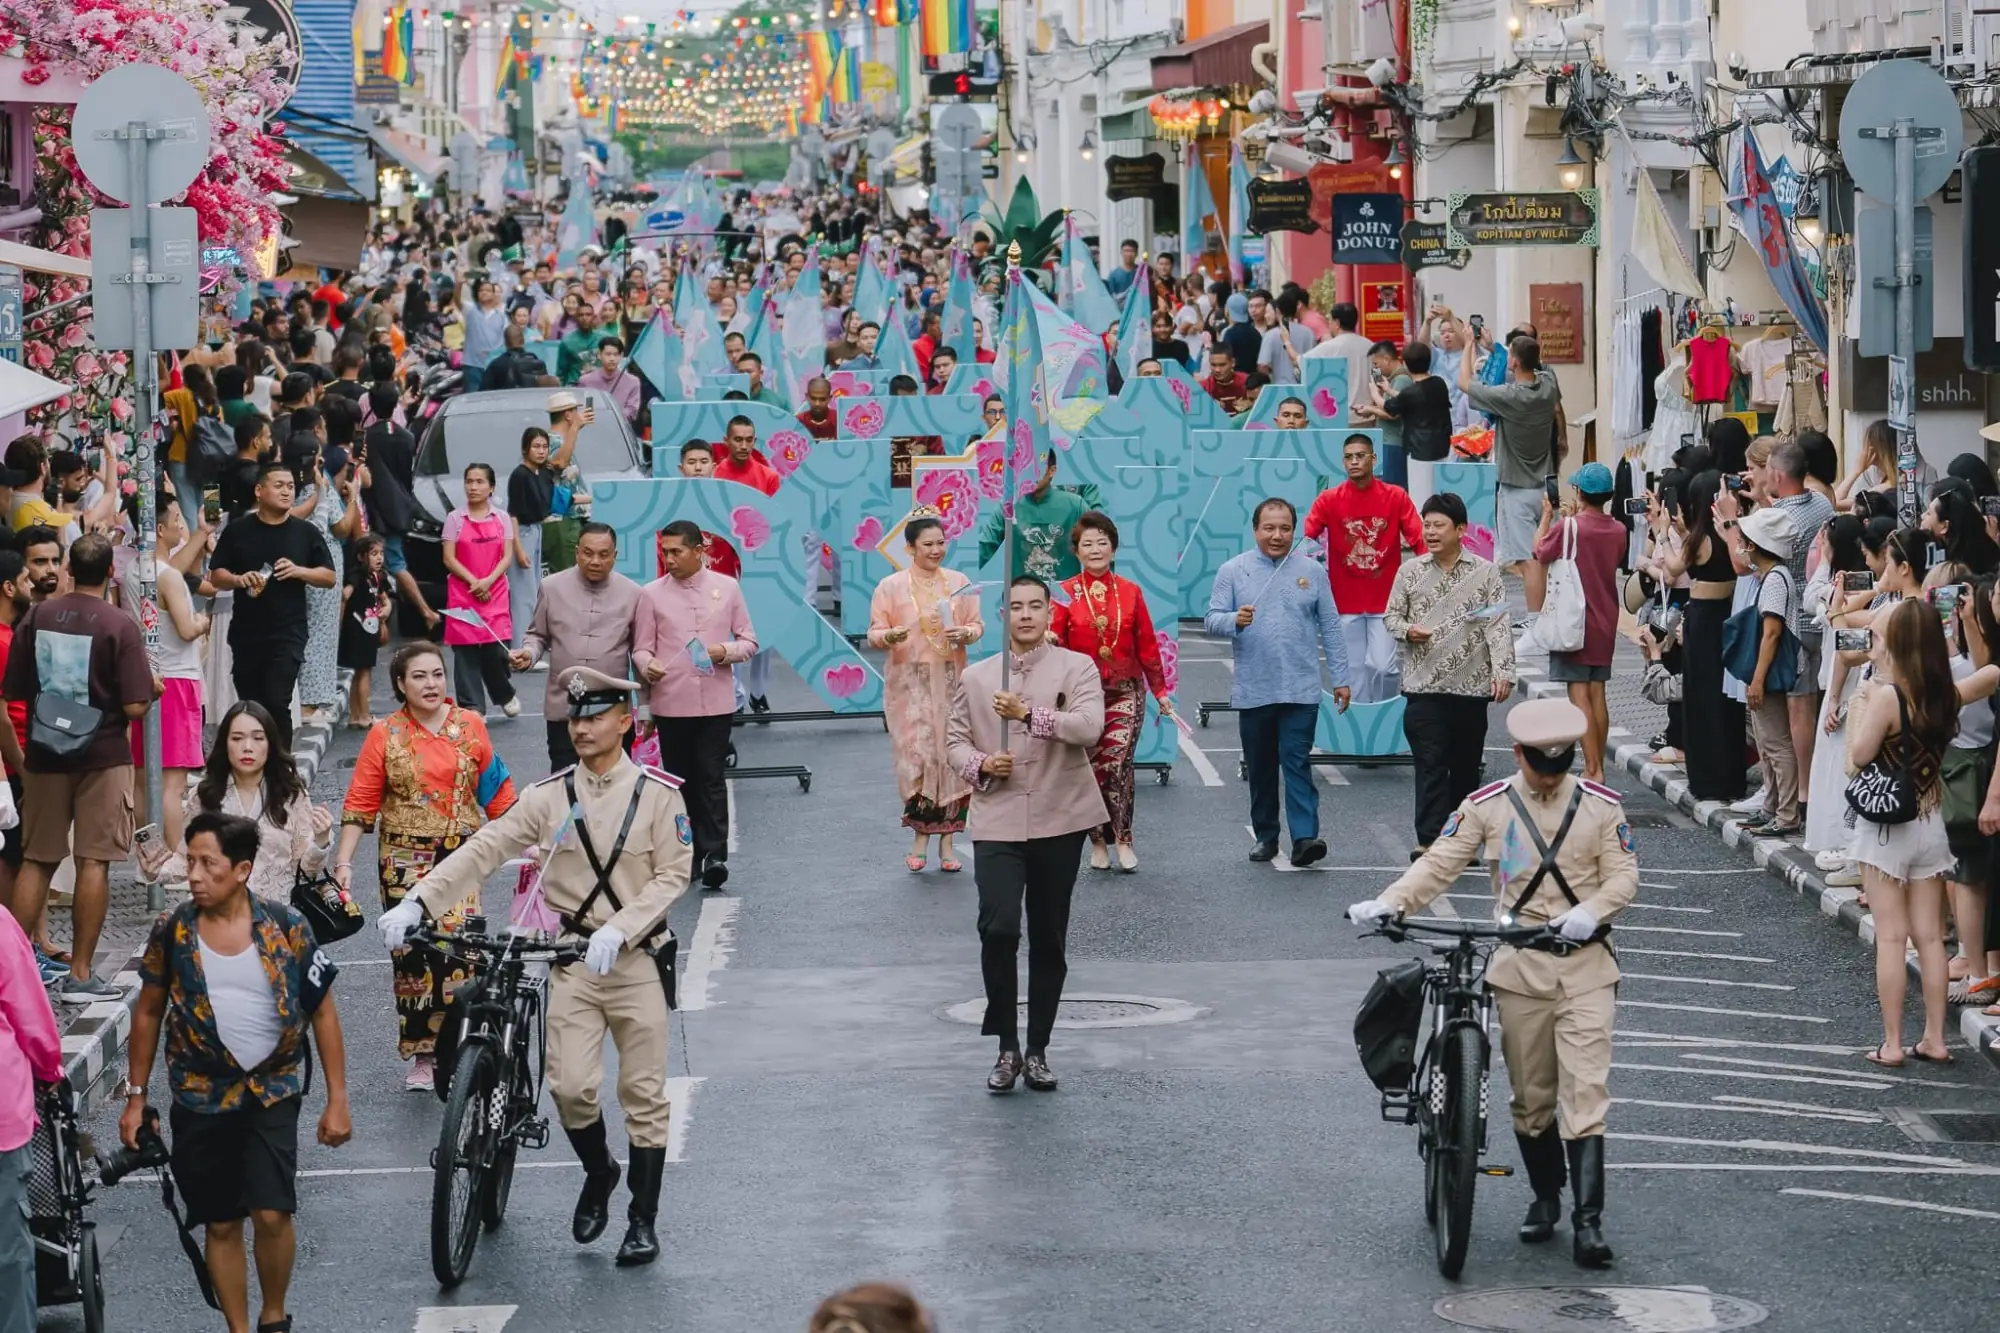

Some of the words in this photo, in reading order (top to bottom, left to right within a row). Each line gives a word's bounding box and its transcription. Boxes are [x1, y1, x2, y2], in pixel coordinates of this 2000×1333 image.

[1343, 221, 1392, 237] JOHN
[1476, 230, 1522, 240] KOPITIAM
[1525, 230, 1538, 239] BY
[1541, 230, 1568, 239] WILAI
[1336, 237, 1400, 251] DONUT
[1410, 238, 1440, 249] CHINA
[1921, 374, 1977, 402] shhh.
[1848, 778, 1900, 813] WOMAN
